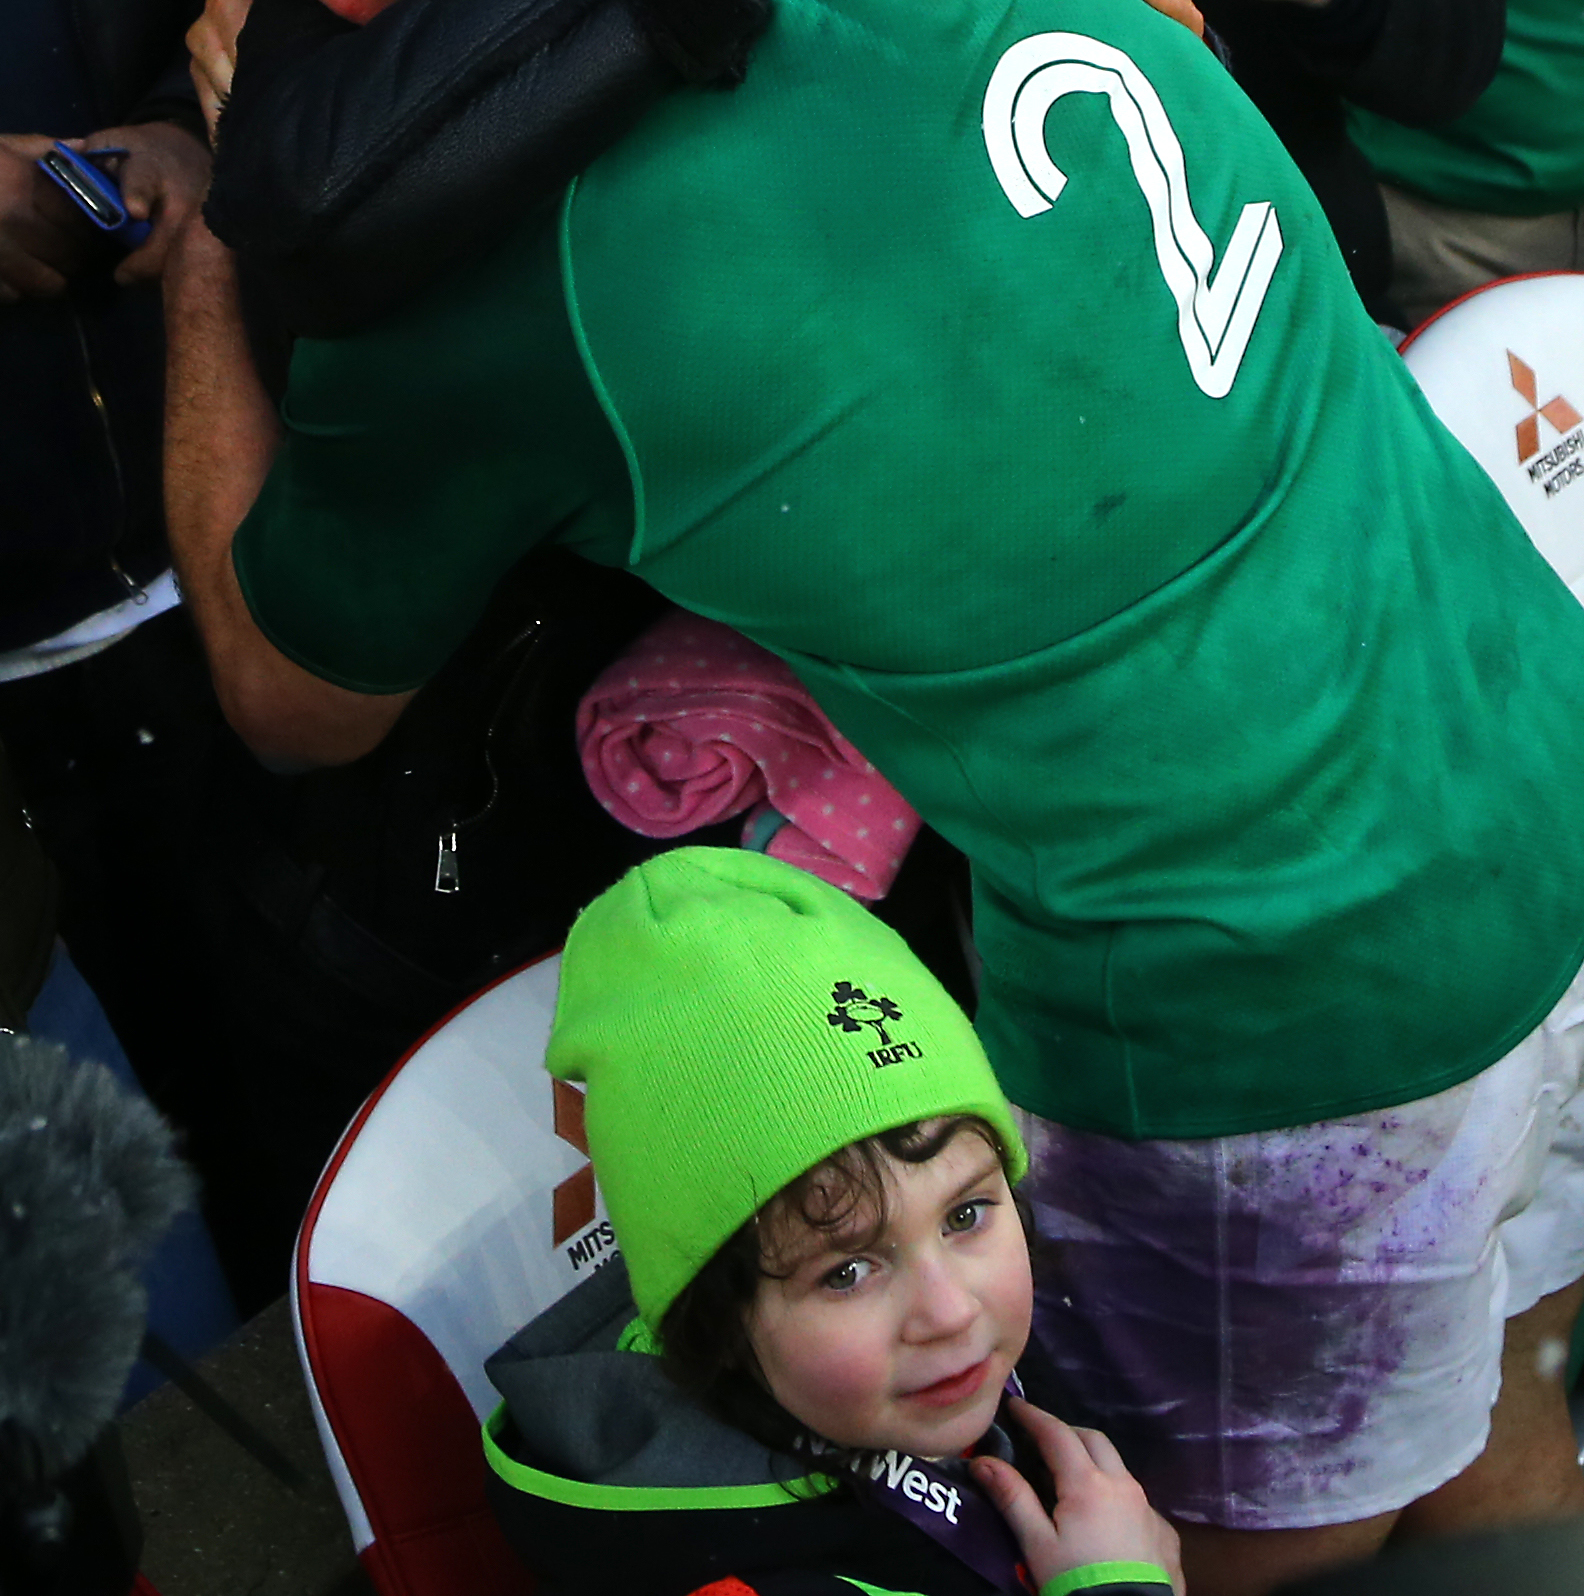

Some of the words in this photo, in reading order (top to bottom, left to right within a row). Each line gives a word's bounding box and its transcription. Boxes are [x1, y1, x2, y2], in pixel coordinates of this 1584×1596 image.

[981, 29, 1285, 400] 2
[1542, 456, 1584, 500] MOTORS
[865, 1040, 924, 1070] IRFU
